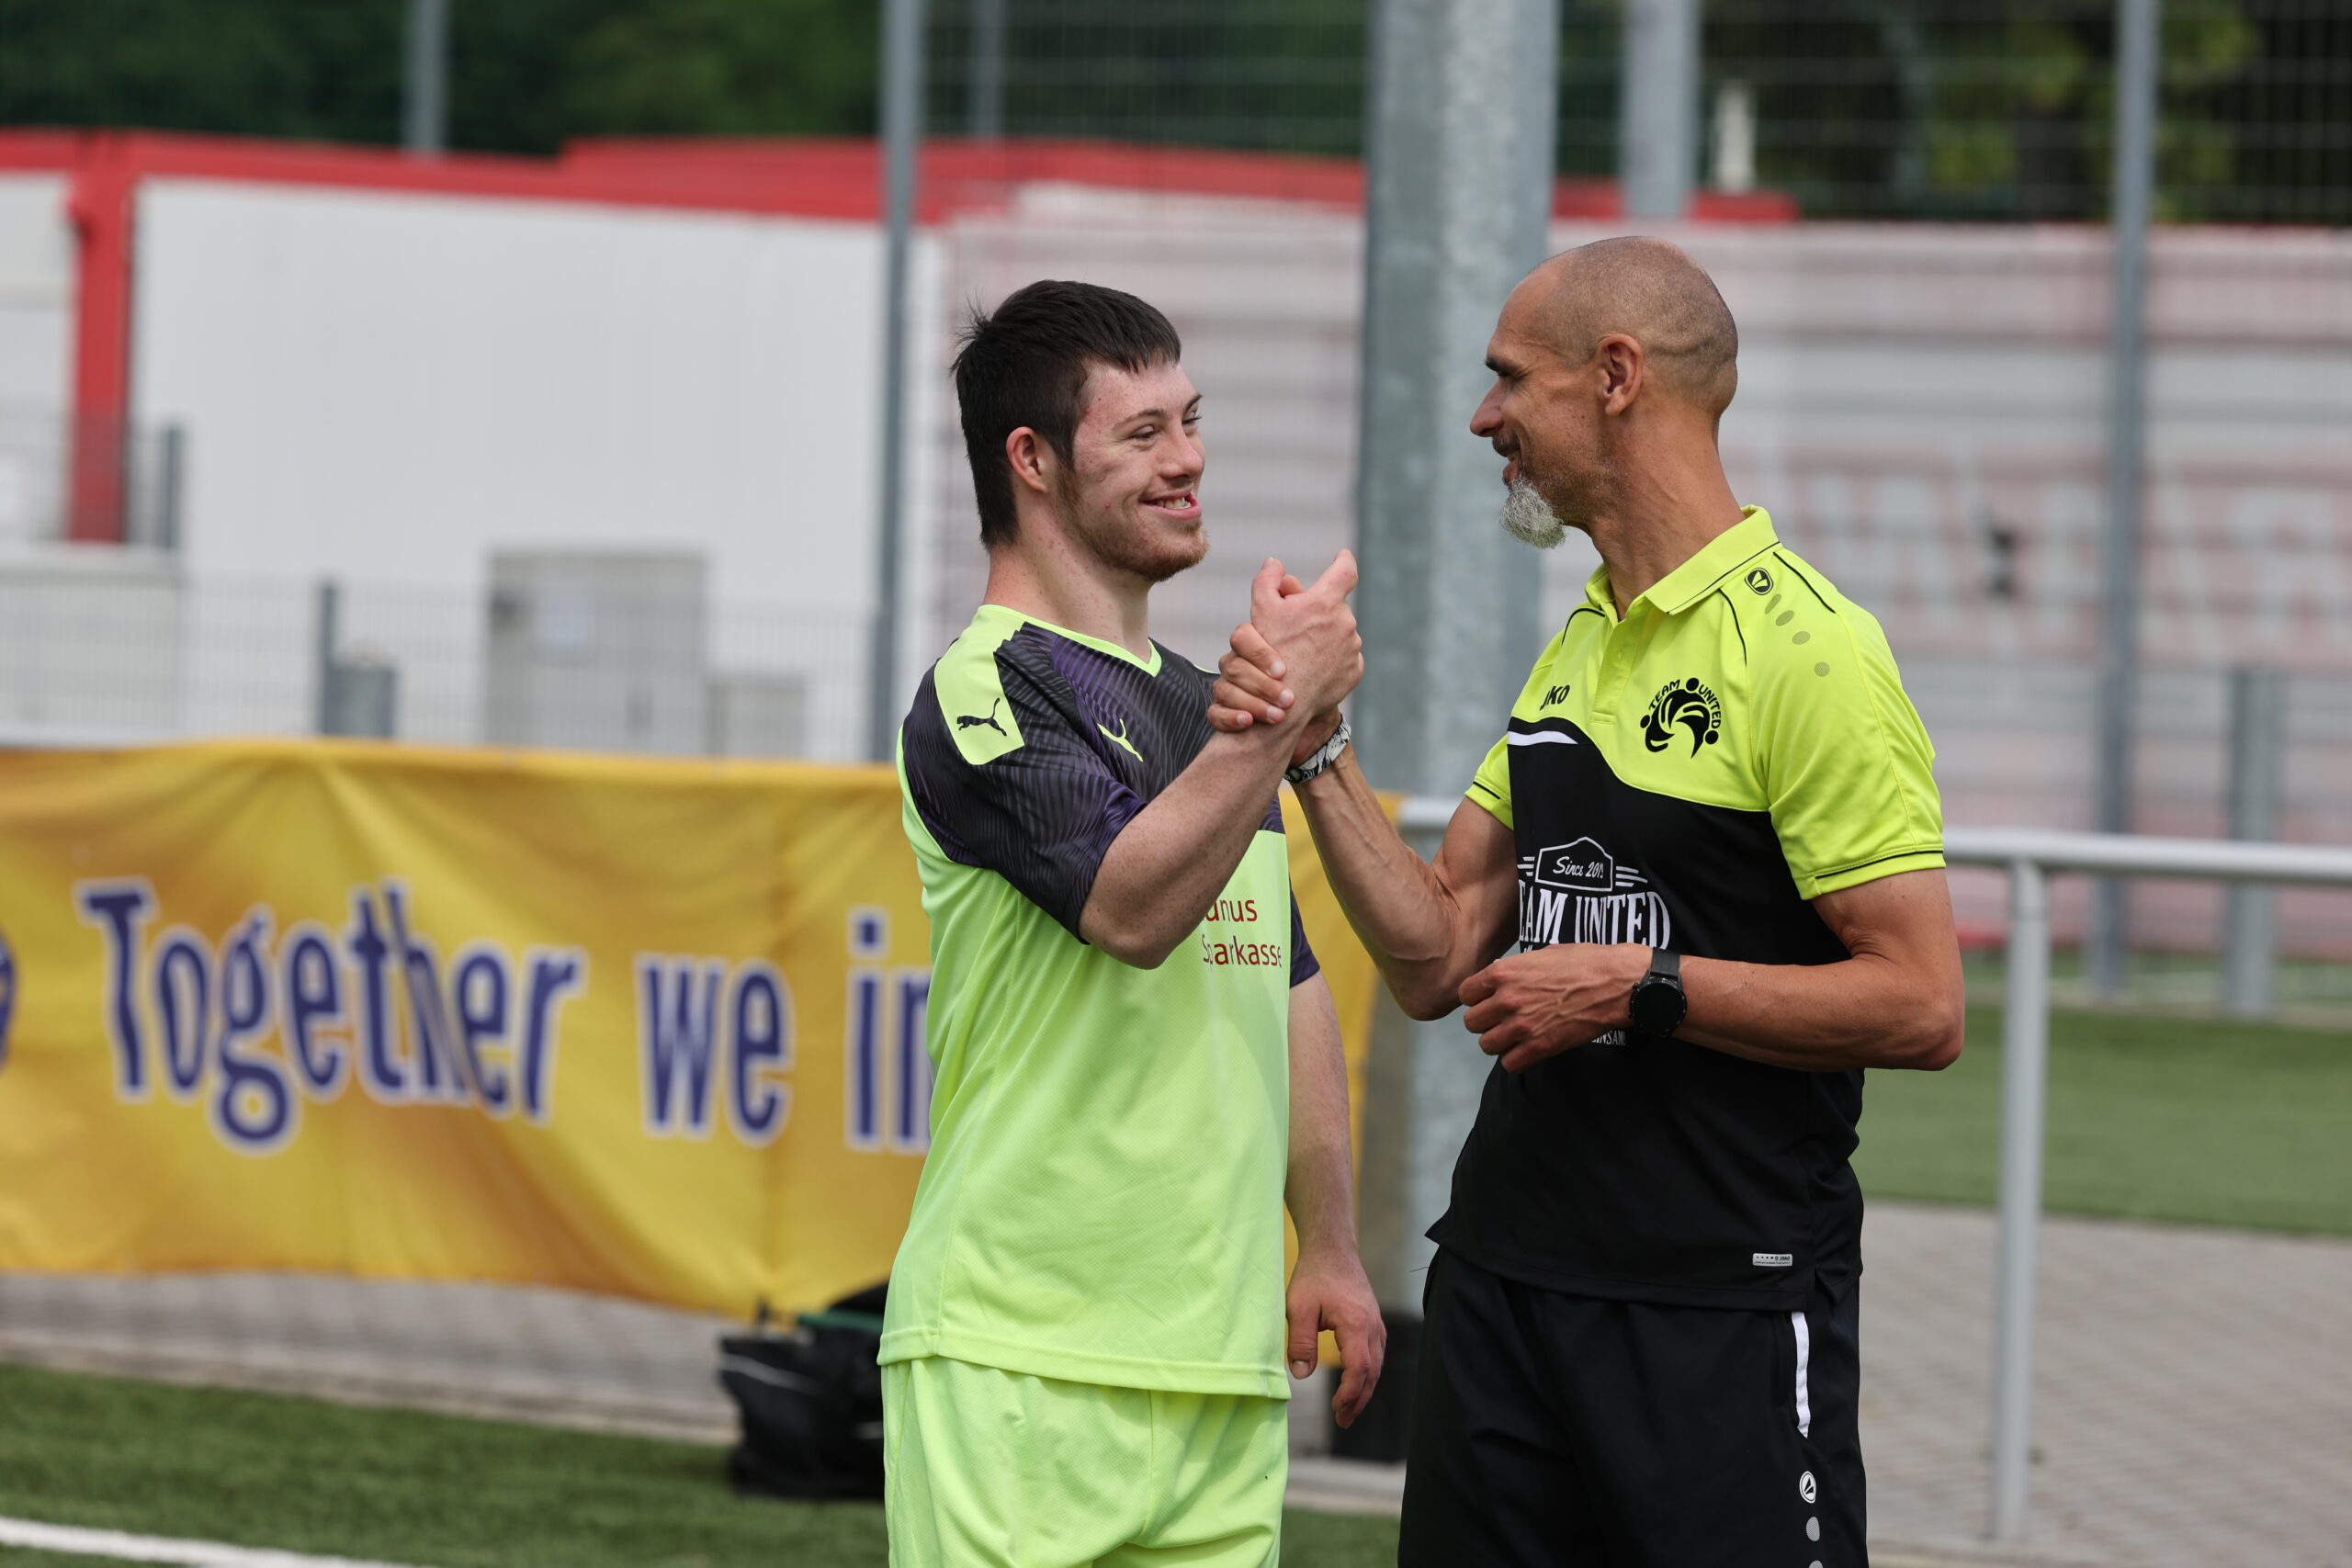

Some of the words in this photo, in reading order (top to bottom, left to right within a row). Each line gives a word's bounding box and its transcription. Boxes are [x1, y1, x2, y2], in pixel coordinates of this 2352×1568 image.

[1648, 678, 1680, 711] TEAM
[1698, 683, 1722, 729] UNITED
[1553, 855, 1583, 877] Since
[1205, 898, 1258, 923] unus
[1518, 878, 1568, 946] EAM
[1575, 890, 1670, 950] UNITED
[78, 880, 585, 1152] Together
[637, 953, 790, 1139] we
